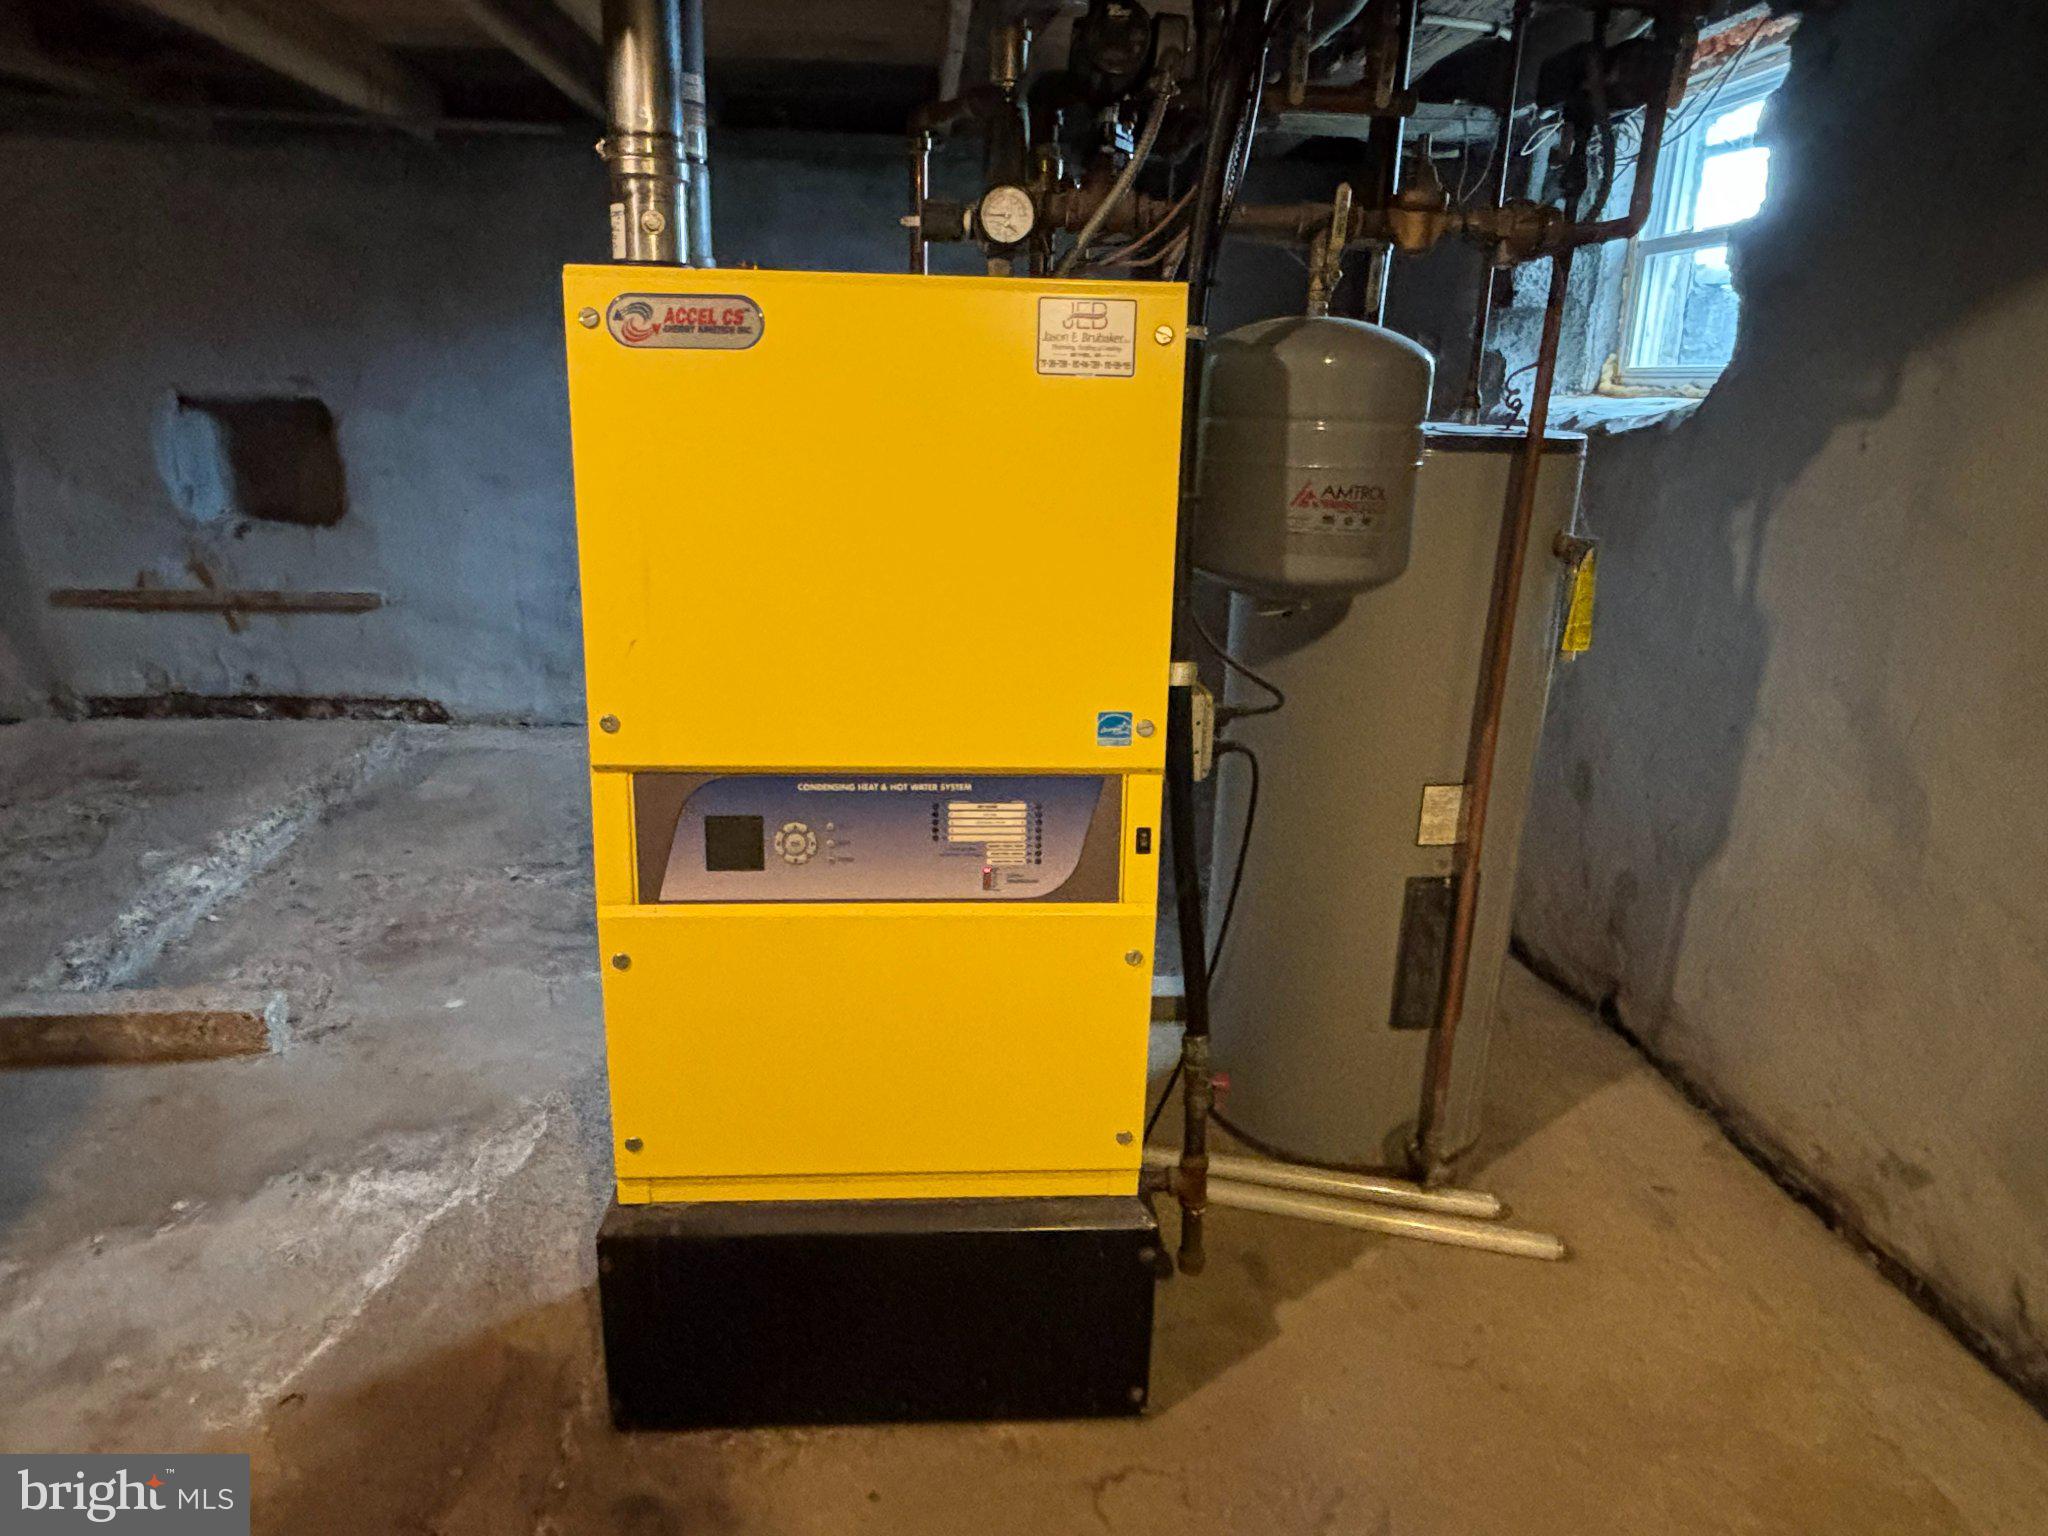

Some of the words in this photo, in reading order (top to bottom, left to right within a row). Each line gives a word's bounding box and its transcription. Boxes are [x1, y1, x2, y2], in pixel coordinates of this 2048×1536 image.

[663, 308, 717, 325] ACCEL
[722, 308, 744, 326] CS
[1063, 302, 1108, 330] JEB
[797, 782, 856, 792] CONDENSING
[858, 782, 879, 792] HEAT
[890, 783, 908, 792] HOT
[910, 783, 938, 792] WATER
[940, 783, 973, 792] SYSTEM
